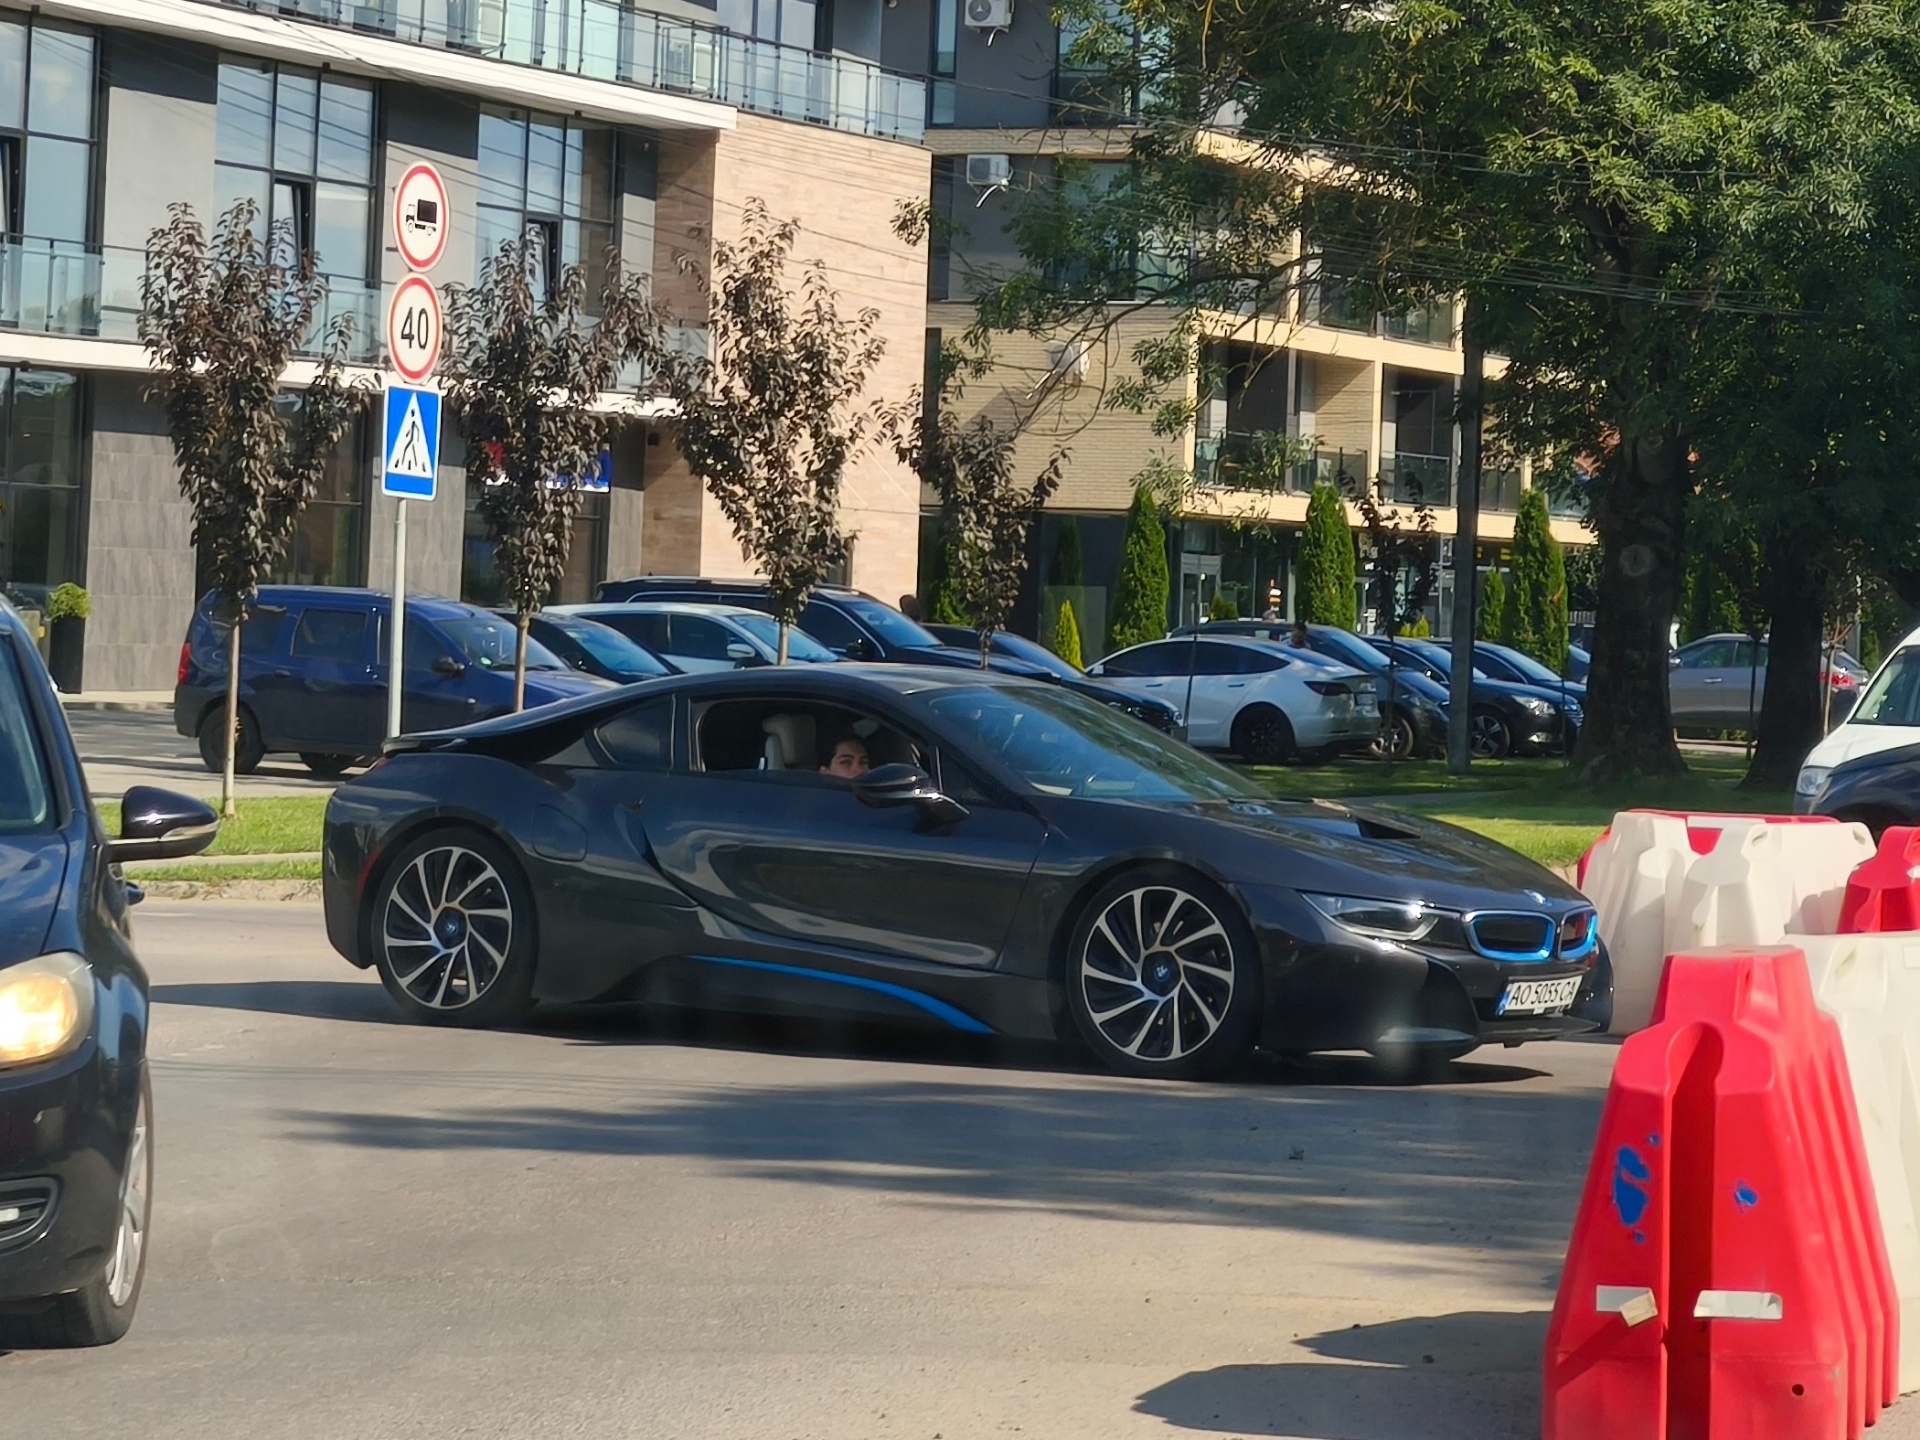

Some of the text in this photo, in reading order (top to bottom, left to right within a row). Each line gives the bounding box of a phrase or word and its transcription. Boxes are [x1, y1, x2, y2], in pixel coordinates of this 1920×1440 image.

[401, 306, 429, 350] 40
[1508, 984, 1531, 1006] AO
[1531, 982, 1561, 1005] 5055
